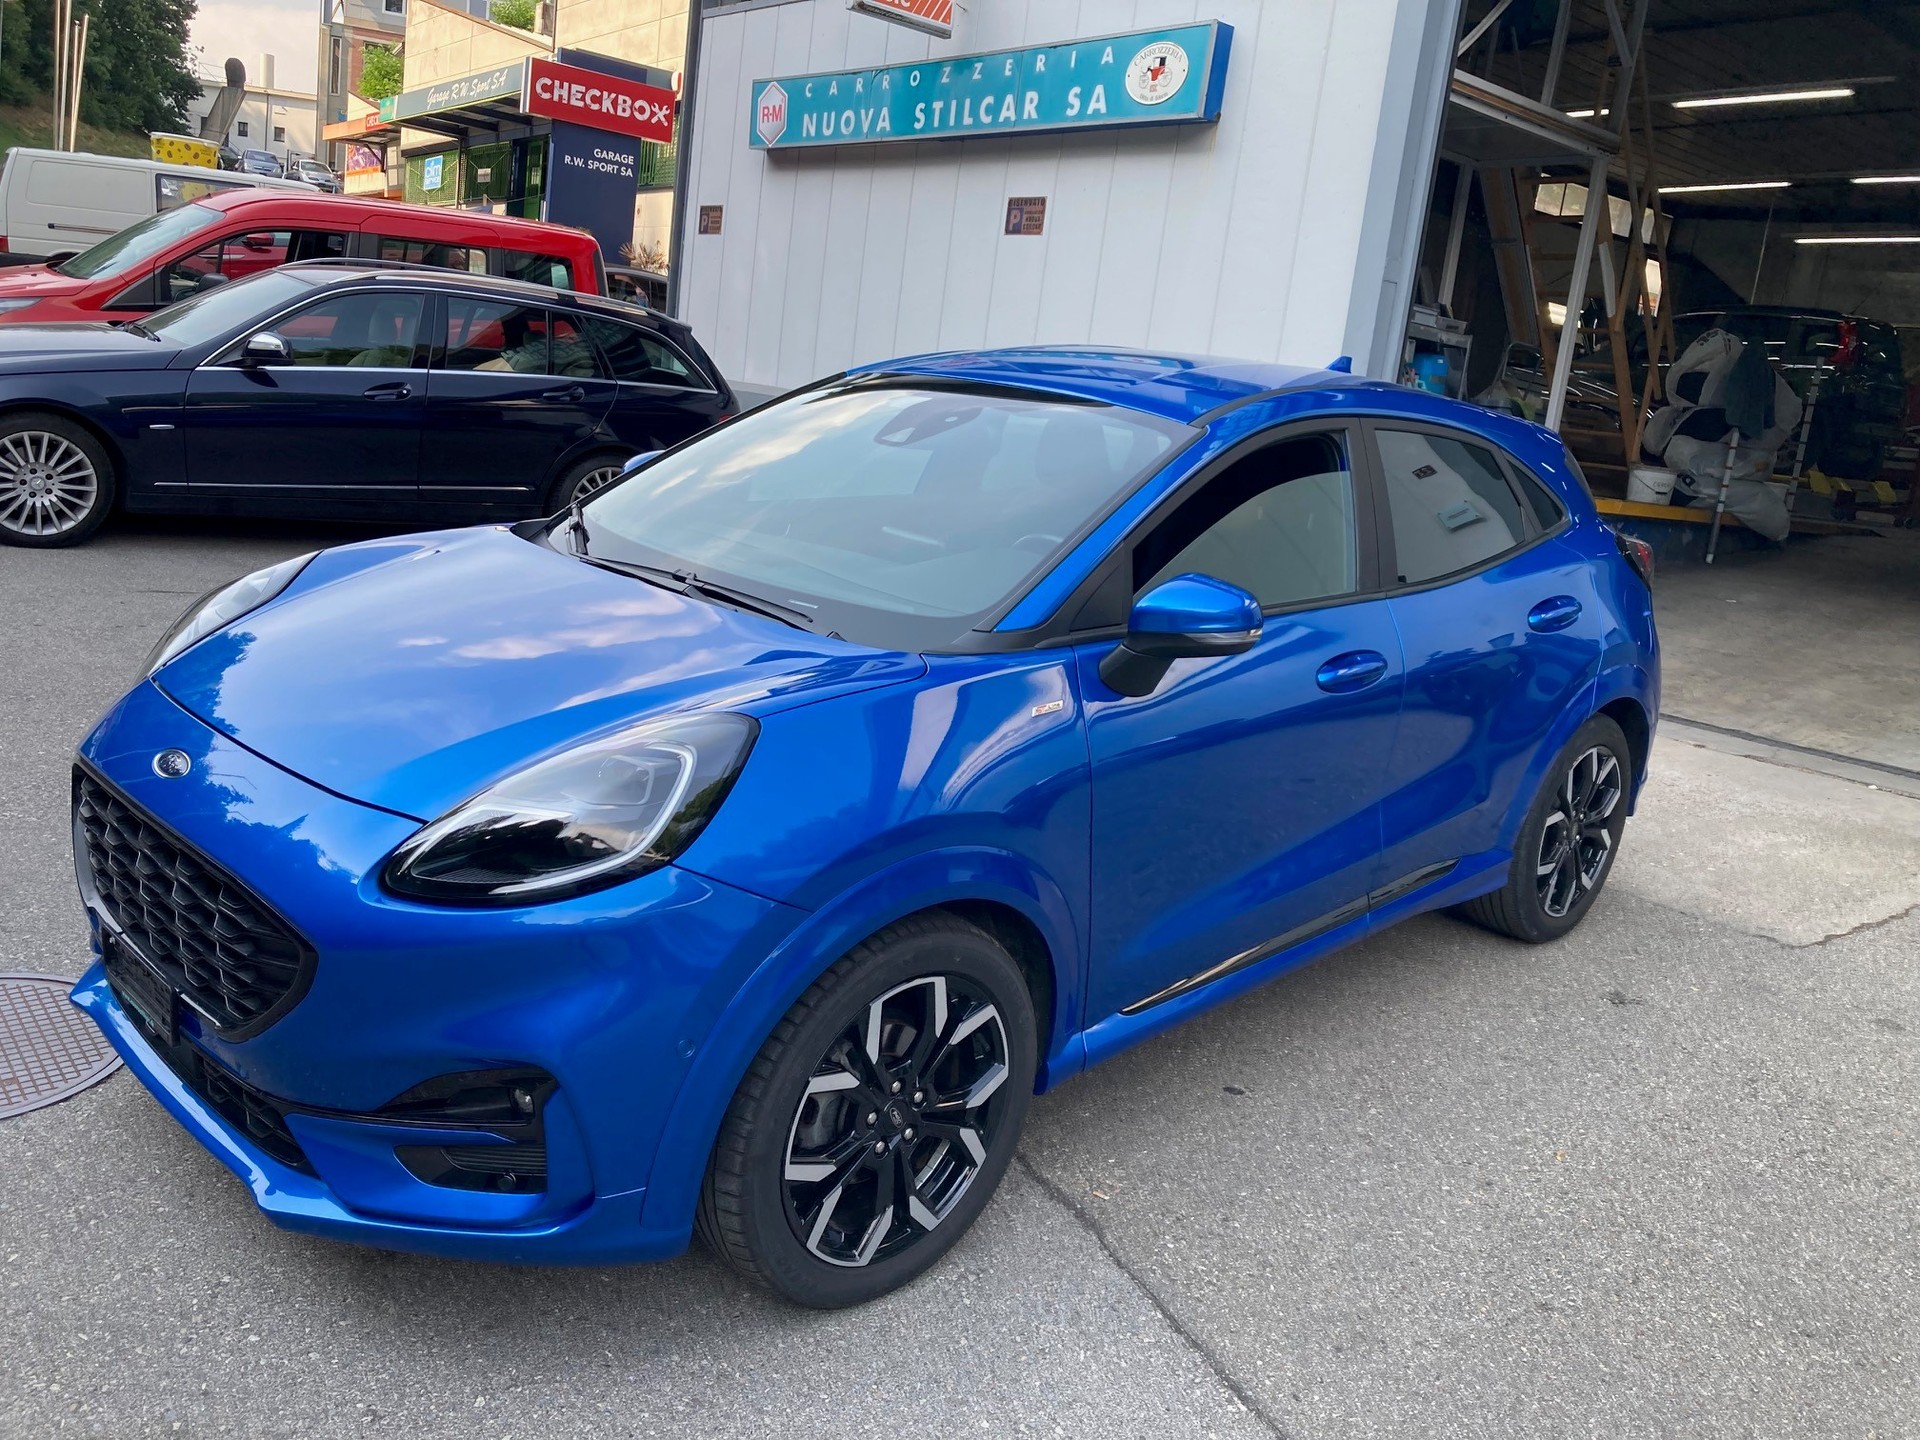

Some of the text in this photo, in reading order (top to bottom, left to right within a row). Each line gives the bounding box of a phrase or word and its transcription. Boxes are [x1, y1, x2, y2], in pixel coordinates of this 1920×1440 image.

[805, 46, 1114, 98] CARROZZERIA
[427, 87, 450, 110] Garage
[535, 76, 670, 127] CHECKBOX
[802, 84, 1108, 138] NUOVA STILCAR SA
[564, 154, 634, 178] R.W. SPORT SA
[593, 148, 634, 165] GARAGE
[1009, 209, 1021, 231] P
